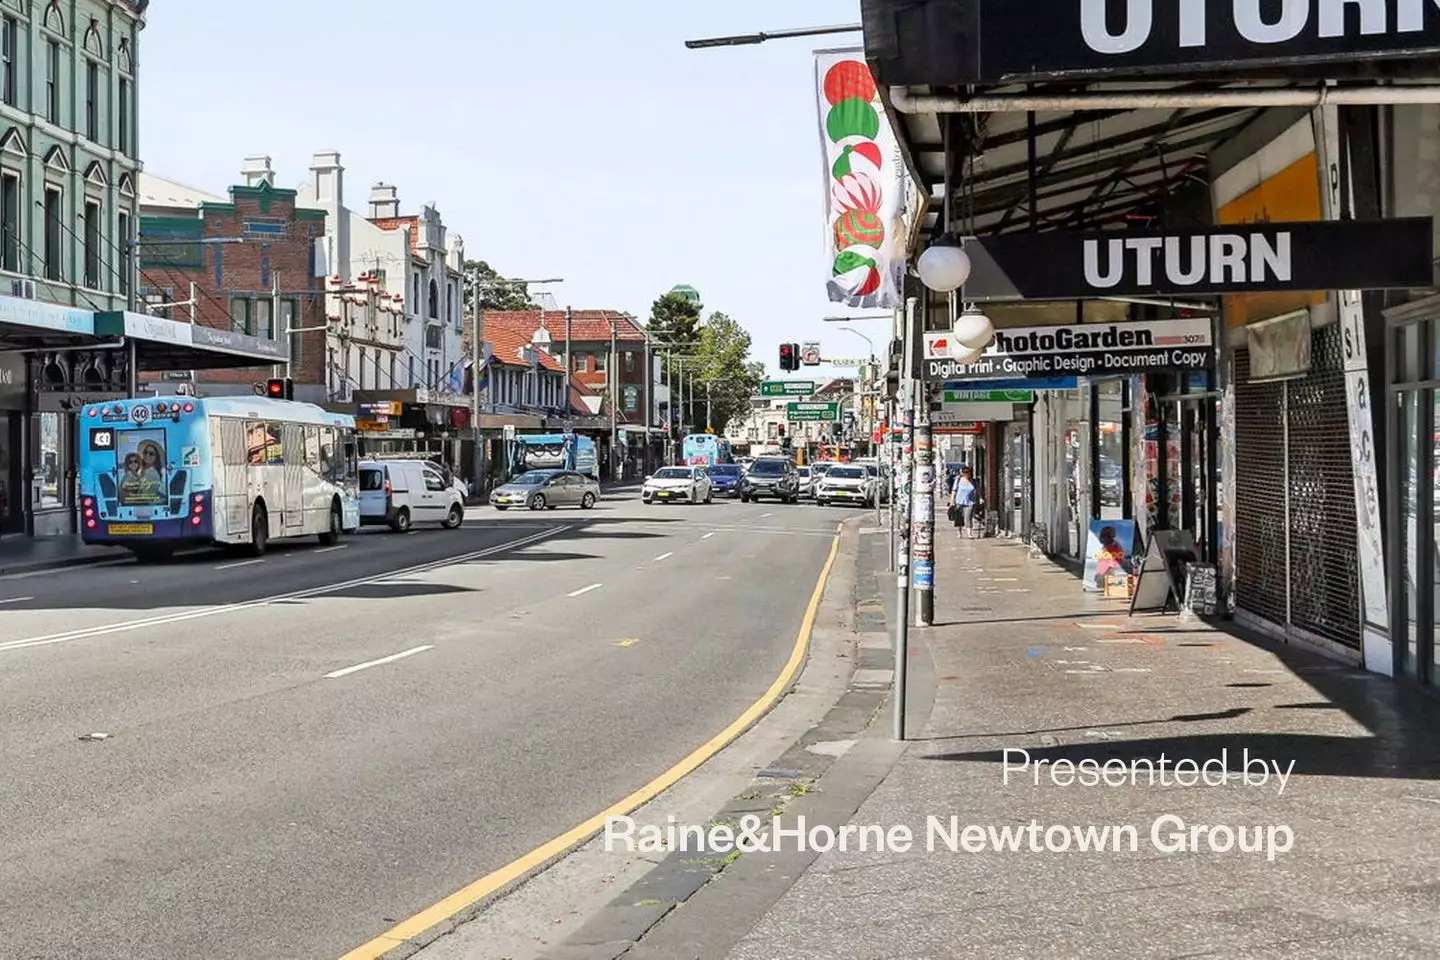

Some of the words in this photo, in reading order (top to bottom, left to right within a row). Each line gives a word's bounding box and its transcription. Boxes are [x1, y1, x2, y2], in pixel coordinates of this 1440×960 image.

[1083, 232, 1292, 289] UTURN
[984, 327, 1153, 354] hotoGarden
[930, 360, 965, 379] Digital
[969, 360, 994, 374] Print
[1003, 358, 1050, 374] Graphic
[1054, 356, 1095, 372] Design
[1104, 352, 1169, 368] Document
[1172, 350, 1207, 367] Copy
[133, 409, 148, 419] 40
